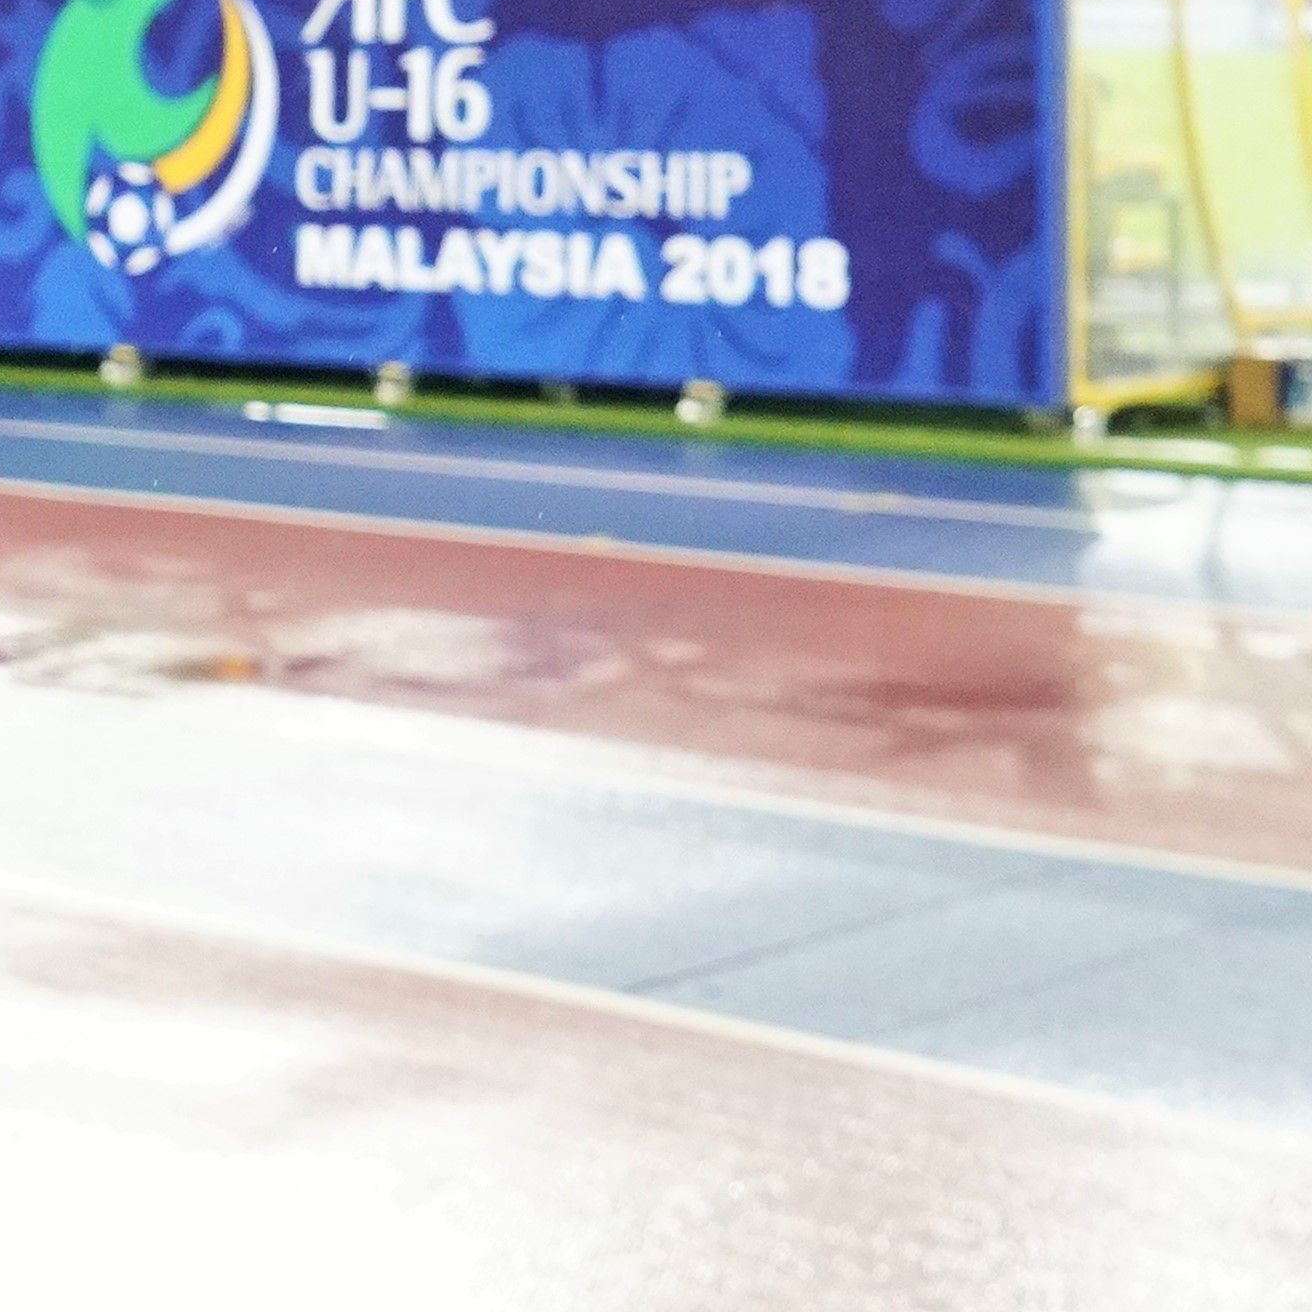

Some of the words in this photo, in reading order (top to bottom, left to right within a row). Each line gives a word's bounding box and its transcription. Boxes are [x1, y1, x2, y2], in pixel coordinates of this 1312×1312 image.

[307, 46, 492, 142] U-16
[295, 146, 752, 219] CHAMPIONSHIP
[295, 223, 645, 301] MALAYSIA
[660, 234, 851, 311] 2018
